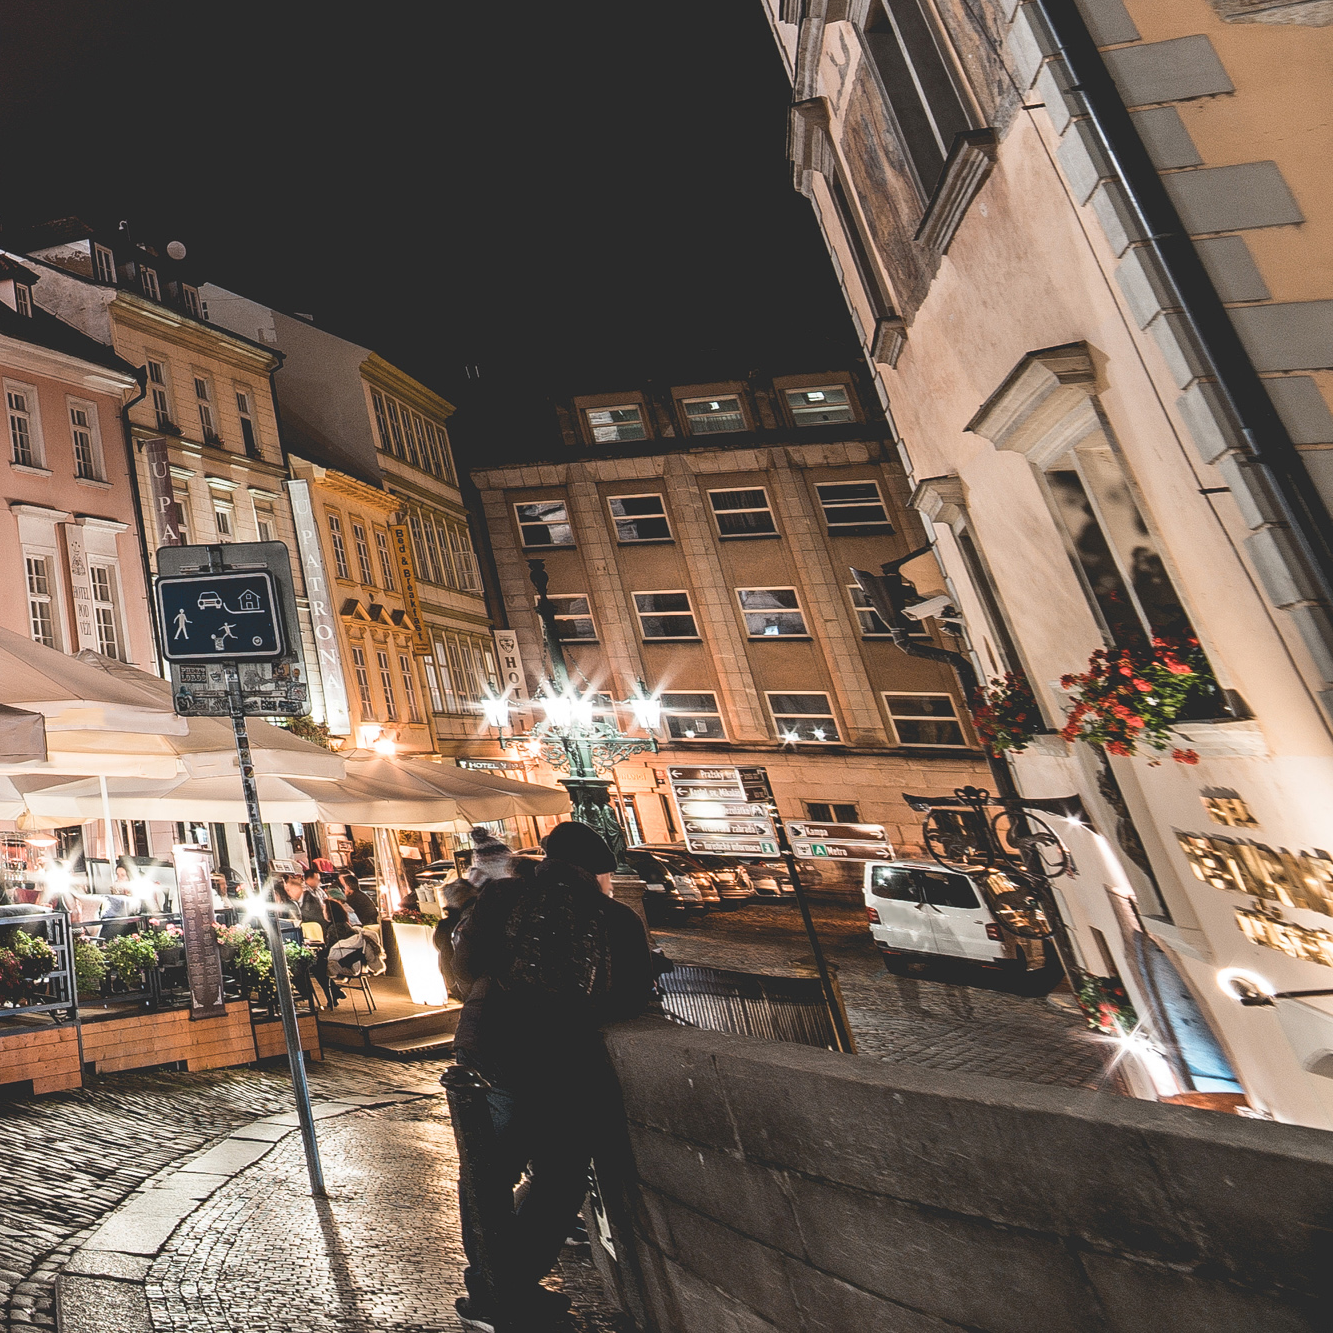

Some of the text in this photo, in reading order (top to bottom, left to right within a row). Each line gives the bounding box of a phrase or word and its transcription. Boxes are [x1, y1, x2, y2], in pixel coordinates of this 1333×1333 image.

[151, 461, 168, 479] U
[395, 529, 406, 553] Bed
[401, 557, 409, 566] &
[73, 586, 90, 600] HOTEL
[295, 499, 342, 689] U PATRONA
[78, 604, 89, 617] POD
[403, 569, 423, 641] Breakfast
[505, 657, 531, 732] HOTL
[699, 769, 724, 780] Pražský
[806, 826, 829, 838] Kampa
[826, 846, 848, 856] Metro
